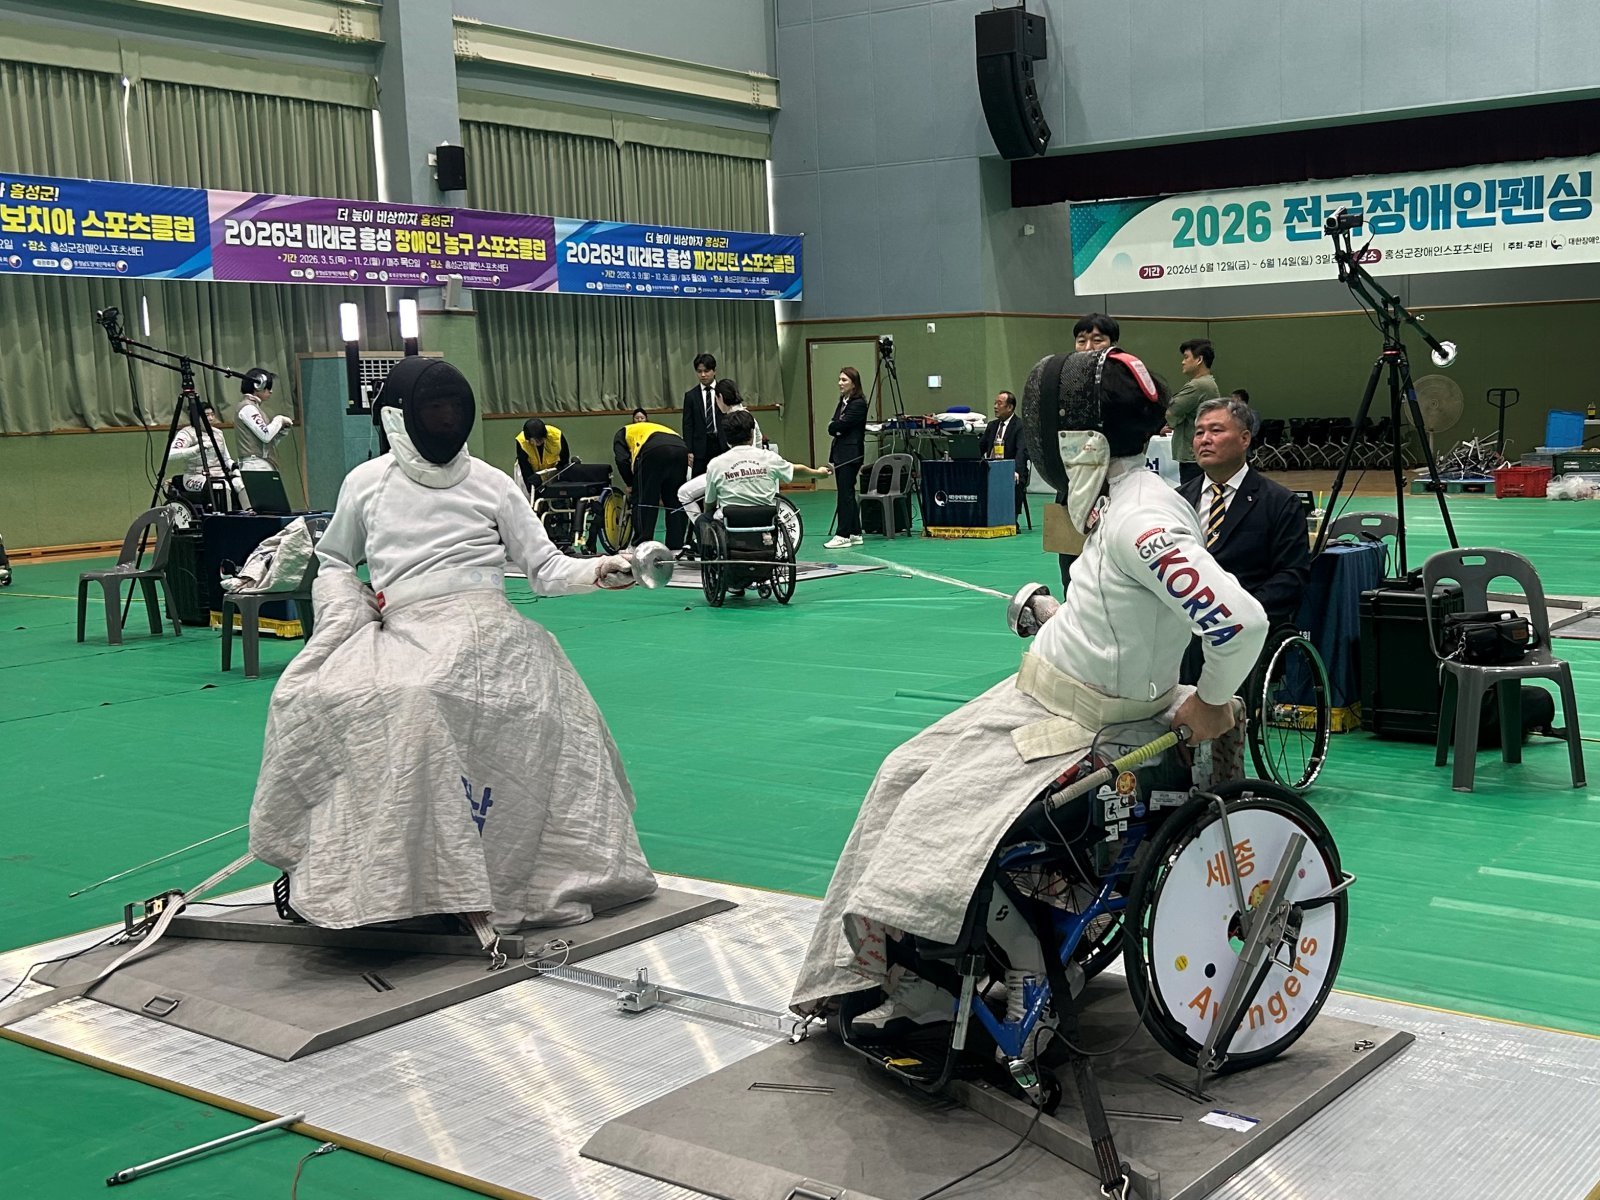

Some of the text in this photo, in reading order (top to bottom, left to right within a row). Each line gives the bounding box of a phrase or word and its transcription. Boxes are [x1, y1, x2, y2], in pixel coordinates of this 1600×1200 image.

[10, 183, 60, 202] 홍성군!
[0, 204, 196, 242] 보치아 스포츠클럽
[337, 208, 454, 228] 더 높이 비상하자 홍성군!
[1172, 201, 1272, 248] 2026
[27, 240, 48, 252] 장소
[50, 241, 145, 257] 홍성군장애인스포츠센터
[224, 219, 547, 262] 2026년 미래로 홍성 장애인 농구 스포츠클럽
[645, 232, 730, 249] 더 높이 비상하자 홍성군!
[1384, 242, 1493, 260] 홍성군장애인스포츠센터
[282, 253, 298, 264] 기간
[299, 254, 321, 266] 2026.
[386, 257, 400, 268] 매주
[400, 257, 421, 269] 목요일
[565, 241, 796, 274] 2026년 미래로 홍성 파라민턴 스포츠클럽
[1142, 267, 1161, 277] 기간
[1166, 264, 1198, 276] 2026년
[1199, 262, 1214, 274] 6월
[1216, 259, 1250, 273] 12일(금)
[1260, 258, 1275, 270] 6월
[1277, 255, 1313, 269] 14일(일)
[725, 471, 740, 480] New
[740, 467, 768, 477] Balance
[1139, 535, 1174, 560] GKL
[1149, 548, 1244, 647] KOREA
